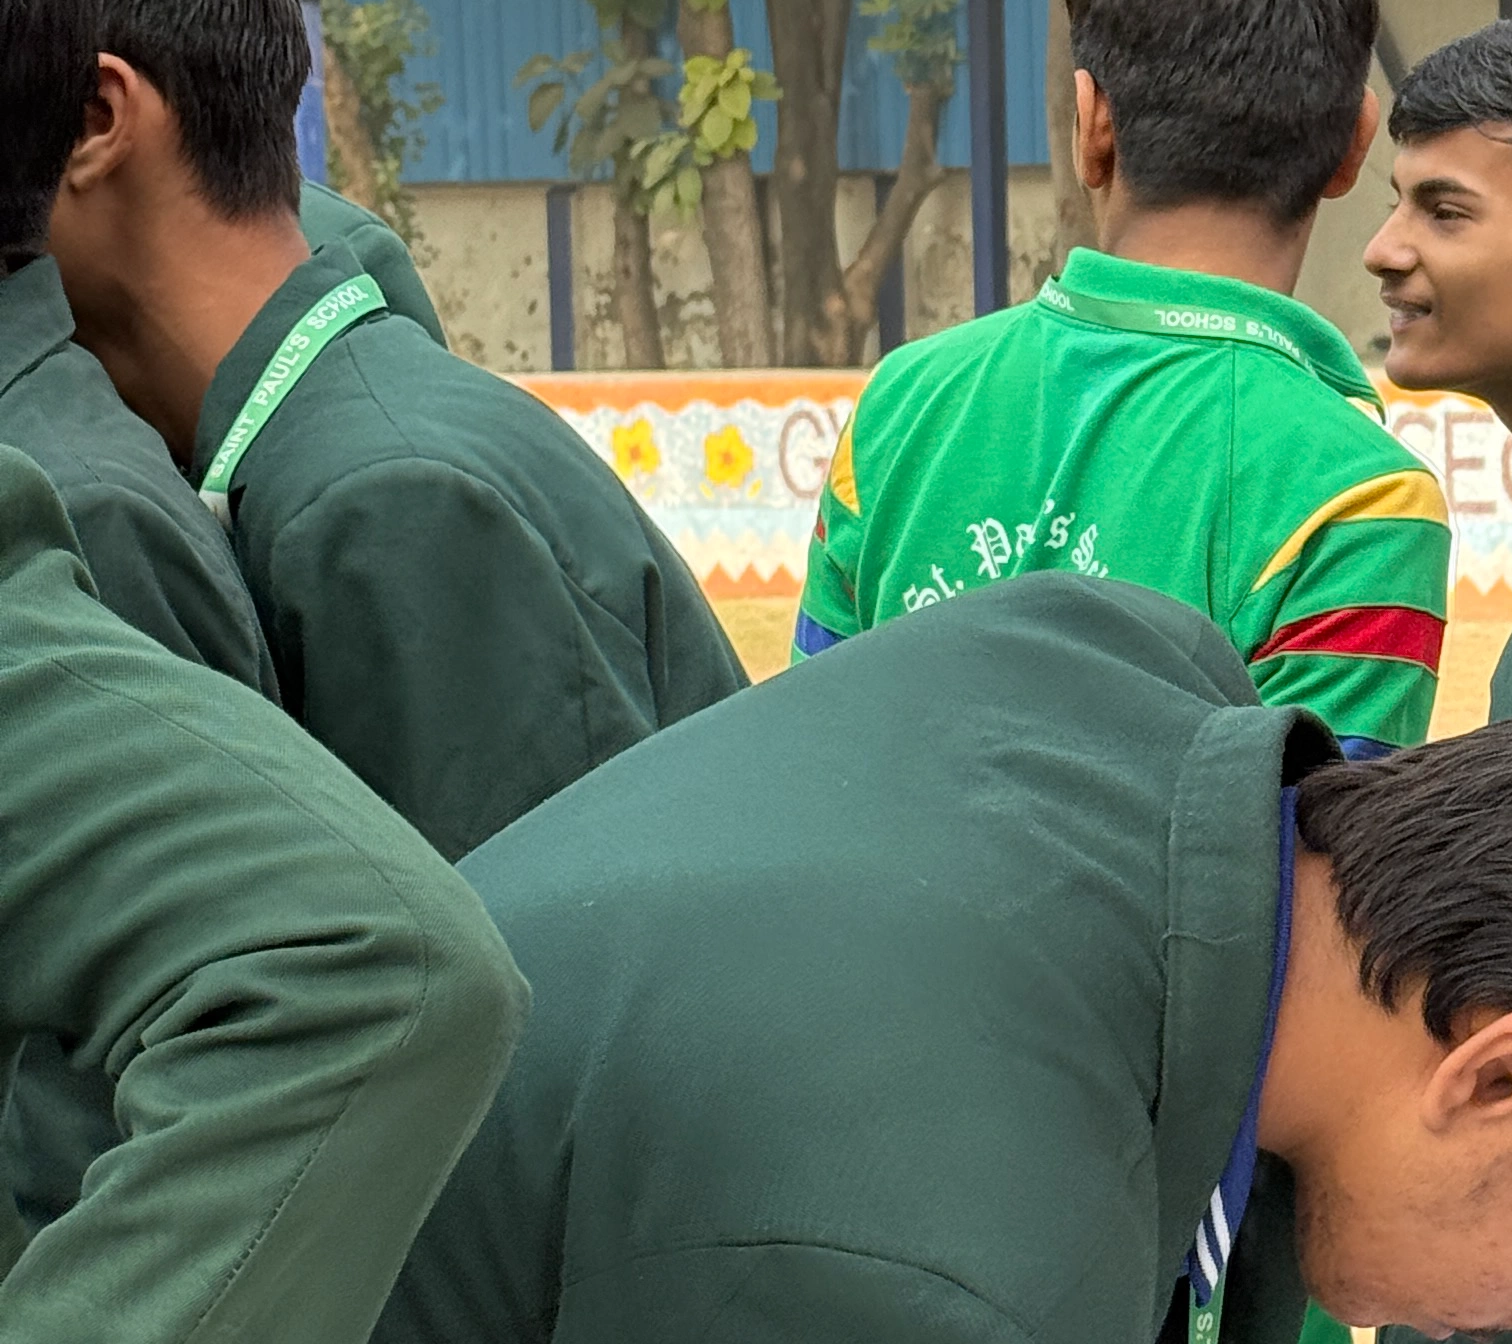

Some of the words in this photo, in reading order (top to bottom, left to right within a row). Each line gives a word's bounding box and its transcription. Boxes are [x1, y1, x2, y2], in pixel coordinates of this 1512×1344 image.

[1154, 309, 1236, 331] SCHOOL
[1246, 321, 1300, 359] PAUL'S
[211, 413, 255, 479] SAINT
[252, 332, 311, 408] PAUL'S
[306, 284, 368, 330] SCHOOL
